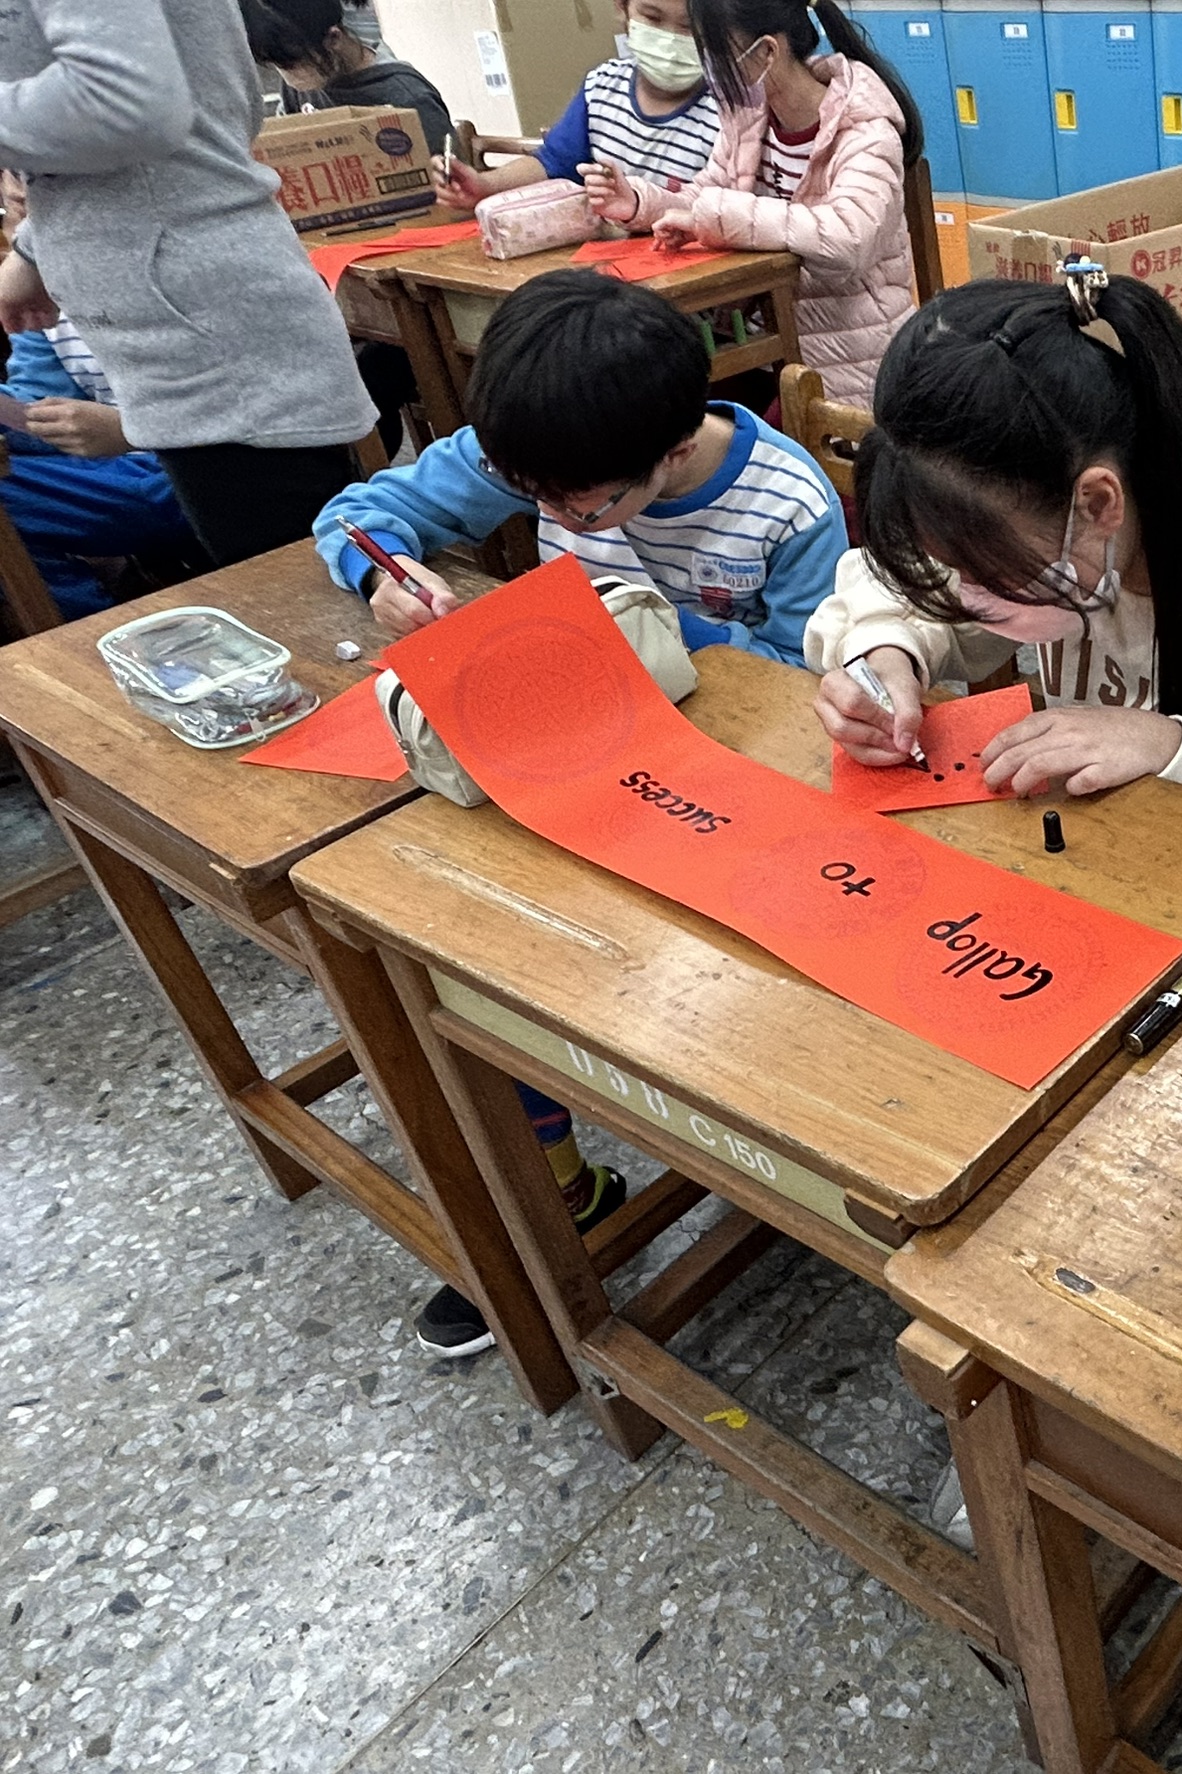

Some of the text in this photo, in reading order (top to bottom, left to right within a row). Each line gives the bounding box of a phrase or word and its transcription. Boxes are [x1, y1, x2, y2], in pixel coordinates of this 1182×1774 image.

[820, 862, 876, 898] to
[926, 912, 1054, 1001] Gallop
[688, 1114, 717, 1147] C
[723, 1133, 777, 1181] 150
